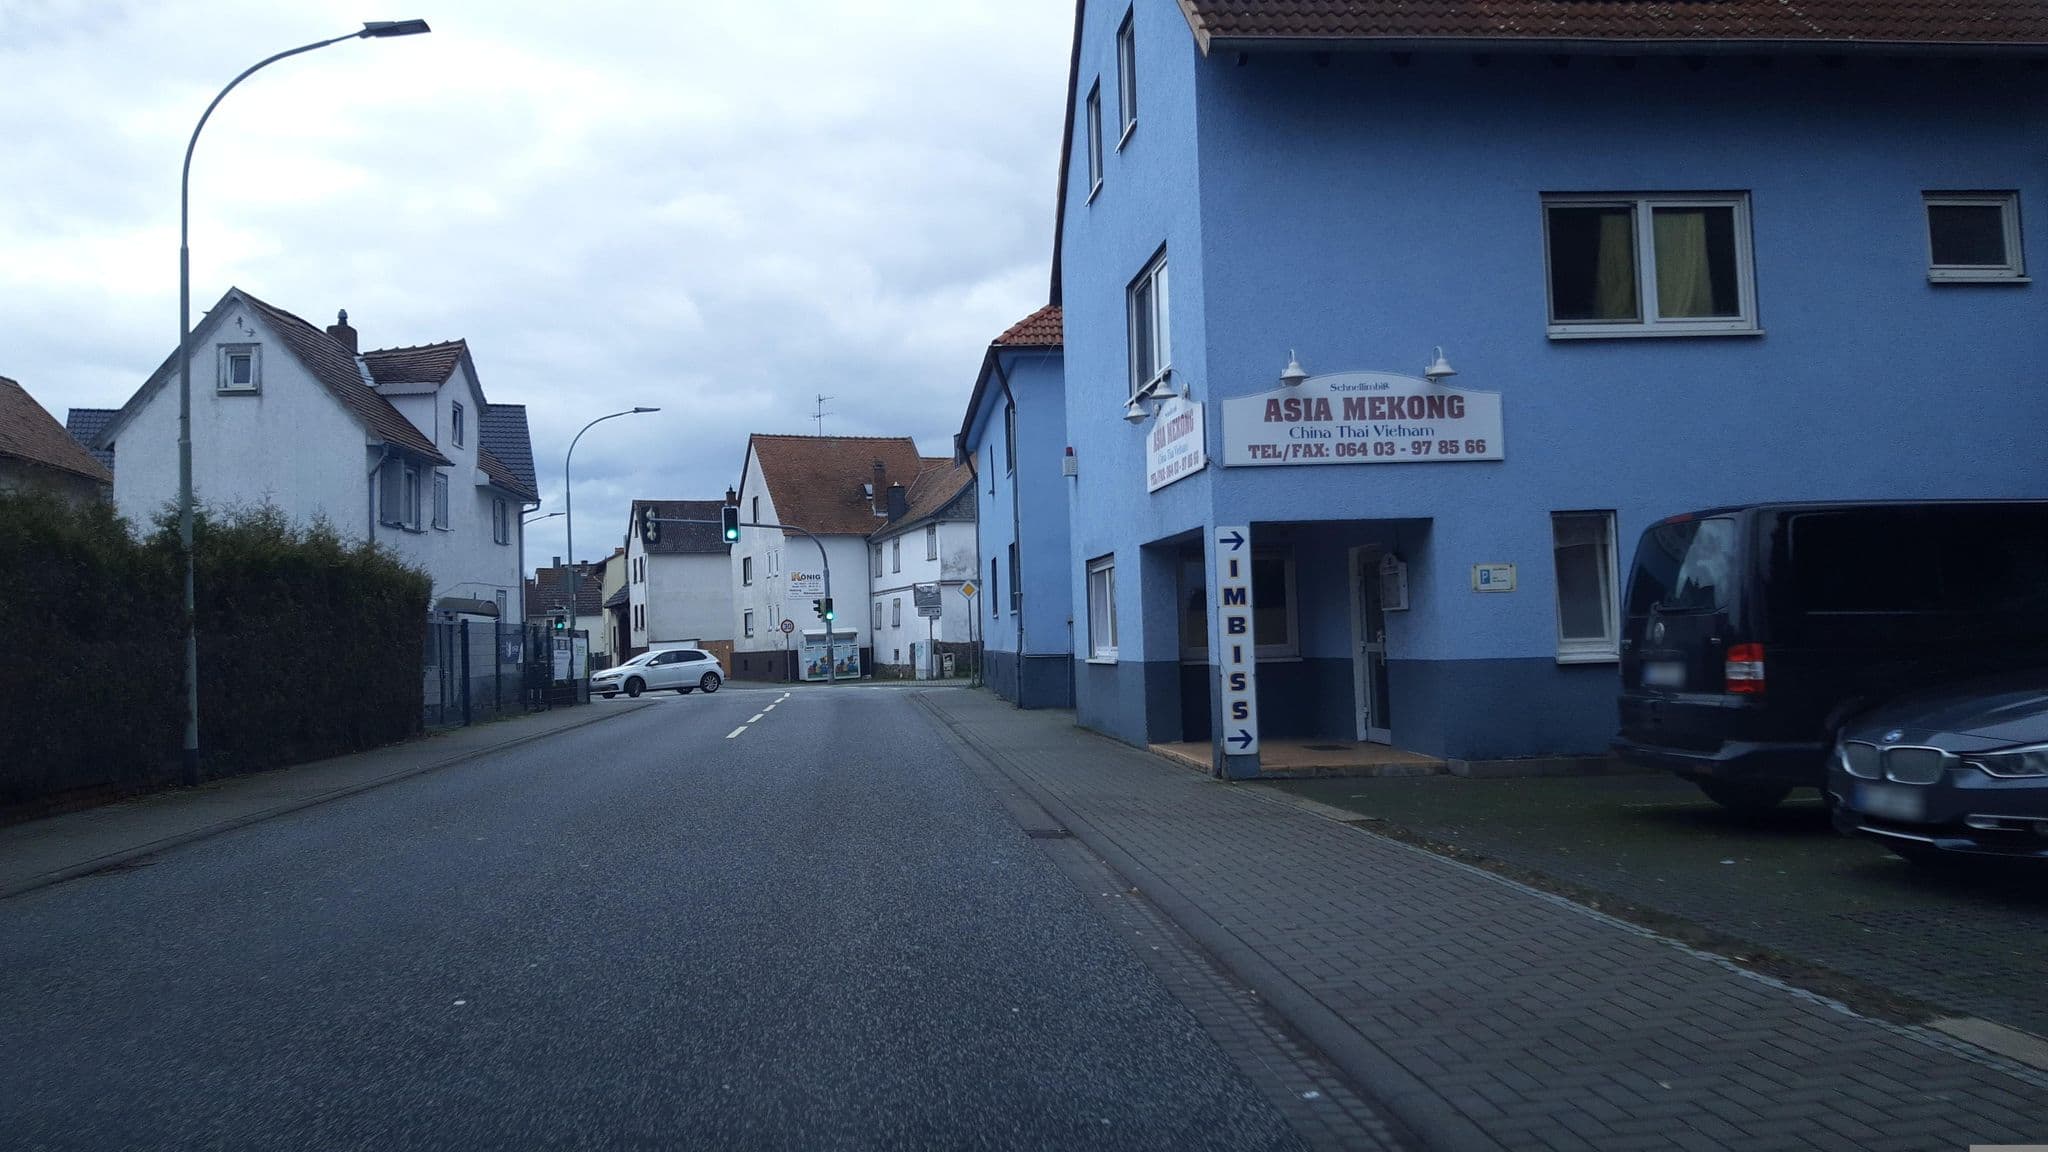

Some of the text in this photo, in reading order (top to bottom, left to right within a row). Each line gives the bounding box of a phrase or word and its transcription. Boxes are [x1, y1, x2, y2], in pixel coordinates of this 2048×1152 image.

[1263, 394, 1465, 422] ASIA MEKONG
[1289, 424, 1435, 439] China Thai Vietnam
[1247, 443, 1330, 461] TEL/FAX:
[1335, 442, 1368, 458] 064
[1373, 441, 1396, 456] 03
[1411, 440, 1432, 455] 97
[1438, 439, 1460, 455] 85
[1464, 438, 1487, 454] 66
[1223, 559, 1248, 720] IMBISS
